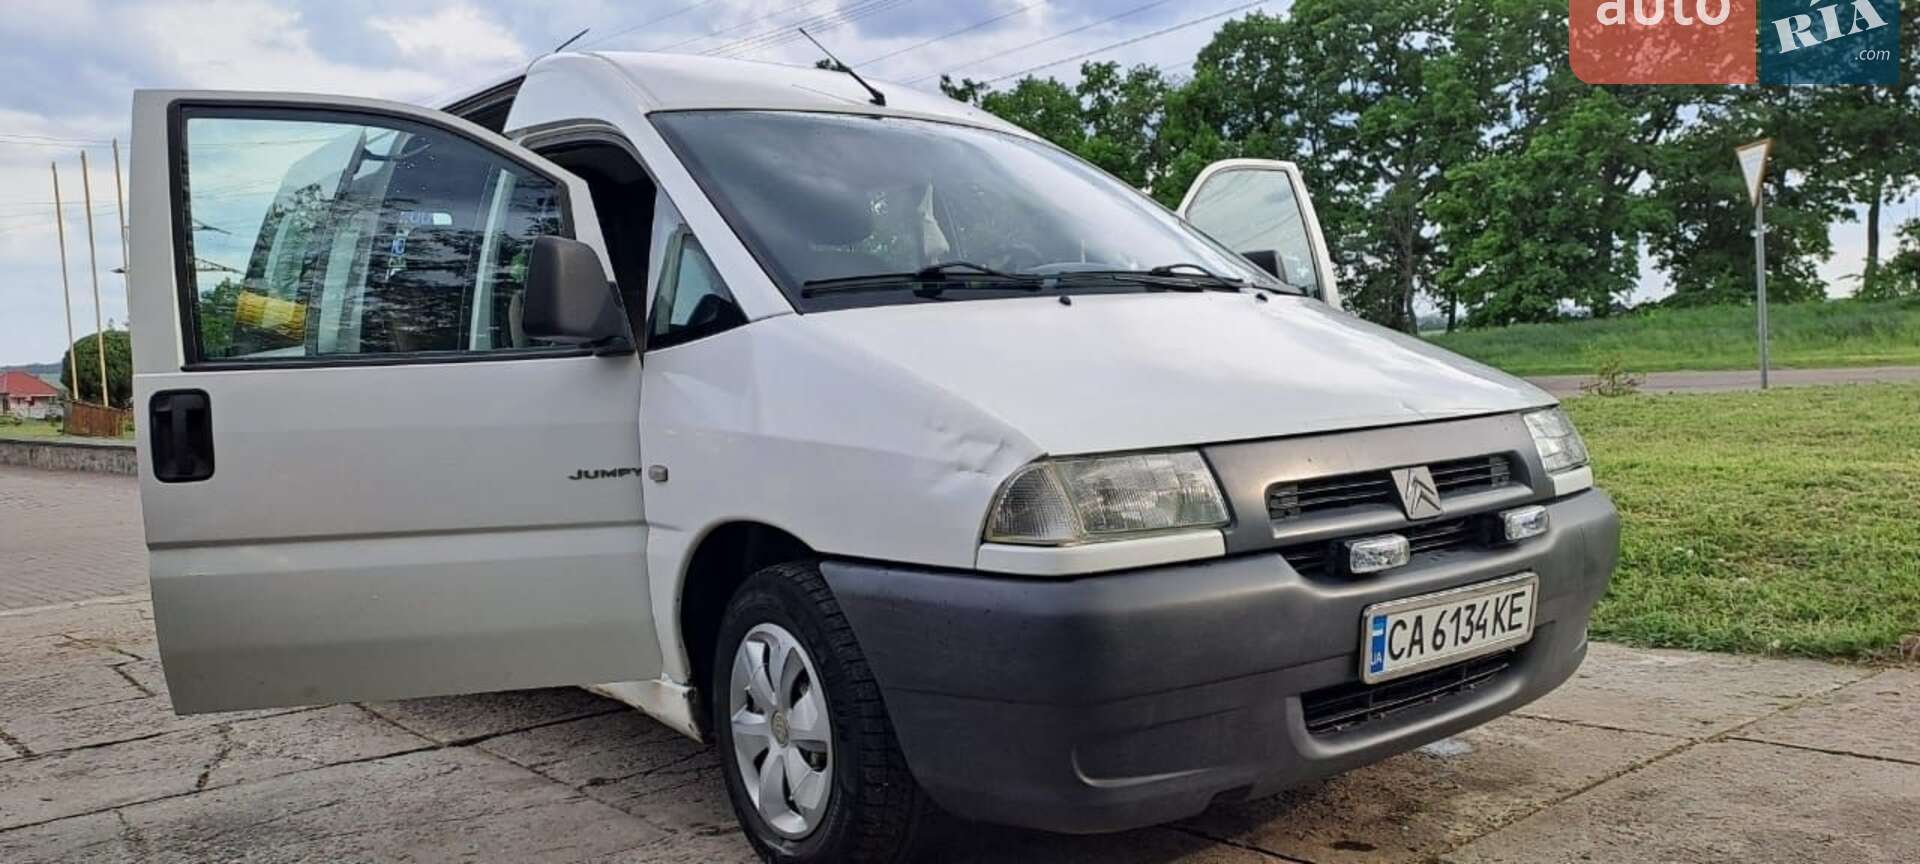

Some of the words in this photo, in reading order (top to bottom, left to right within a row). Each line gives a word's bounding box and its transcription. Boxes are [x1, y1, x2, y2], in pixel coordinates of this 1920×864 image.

[567, 467, 642, 481] JUMPY
[1388, 615, 1425, 661] CA
[1431, 600, 1489, 651] 6134
[1491, 591, 1526, 637] KE
